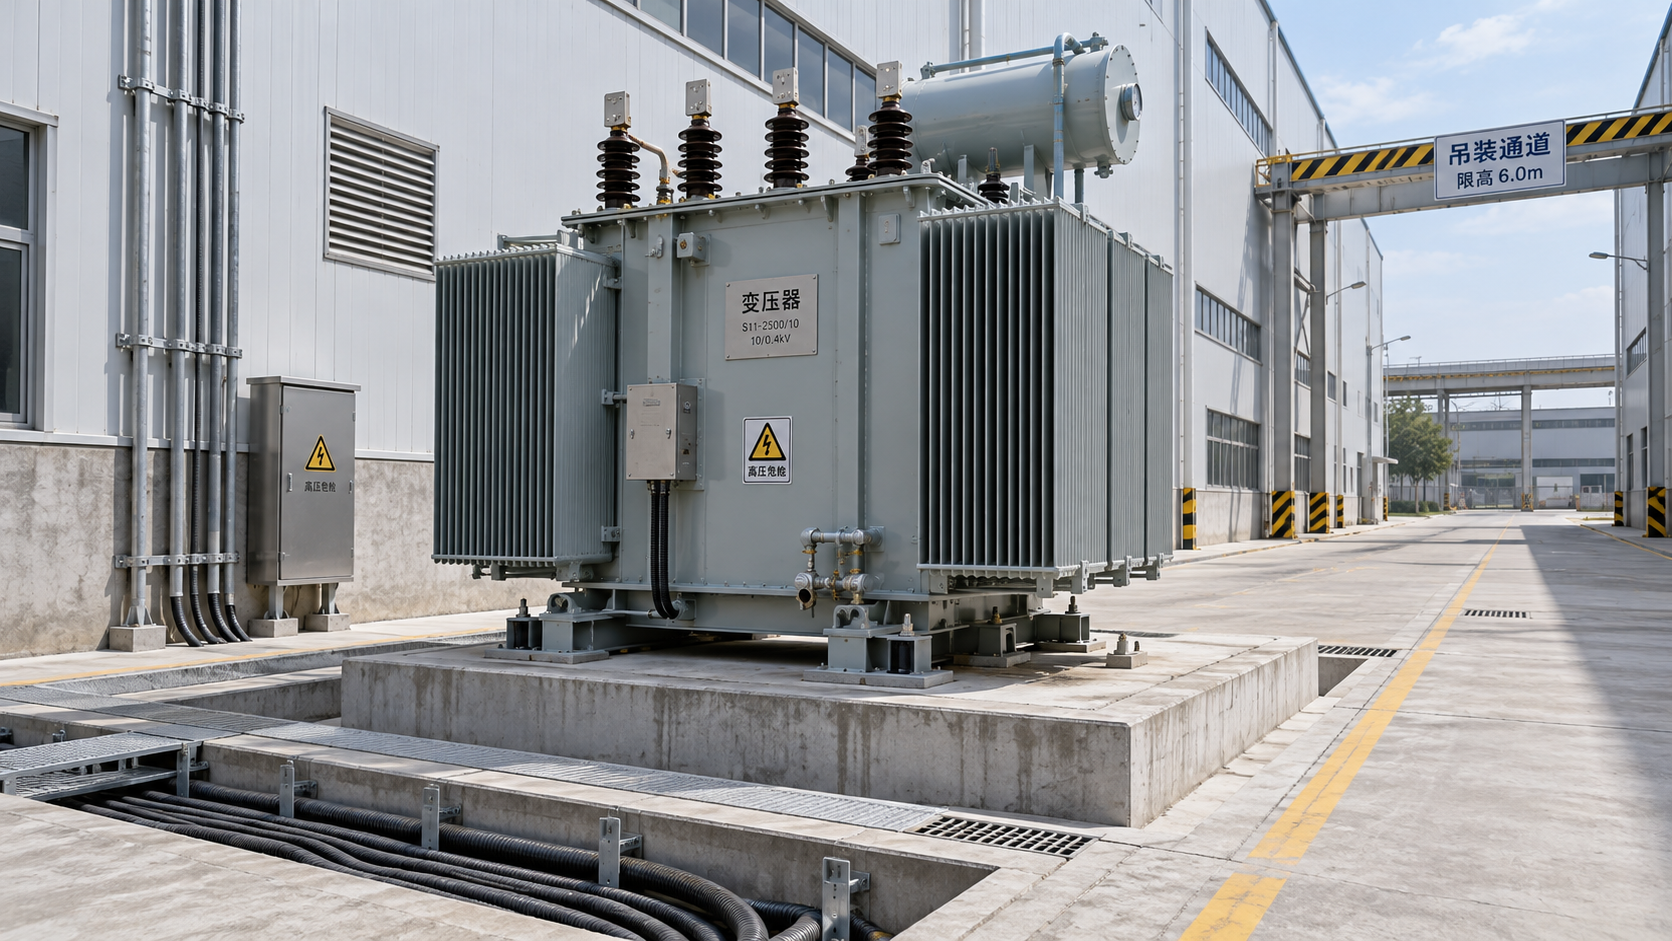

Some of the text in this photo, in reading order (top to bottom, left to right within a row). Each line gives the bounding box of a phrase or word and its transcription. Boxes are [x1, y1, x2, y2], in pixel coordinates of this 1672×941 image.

[1449, 132, 1550, 166] 吊装通道
[1457, 166, 1543, 189] 限高 6.0m
[742, 288, 801, 314] 变压器
[742, 318, 799, 332] S11-2500/10
[751, 334, 791, 346] 10/0.4kV
